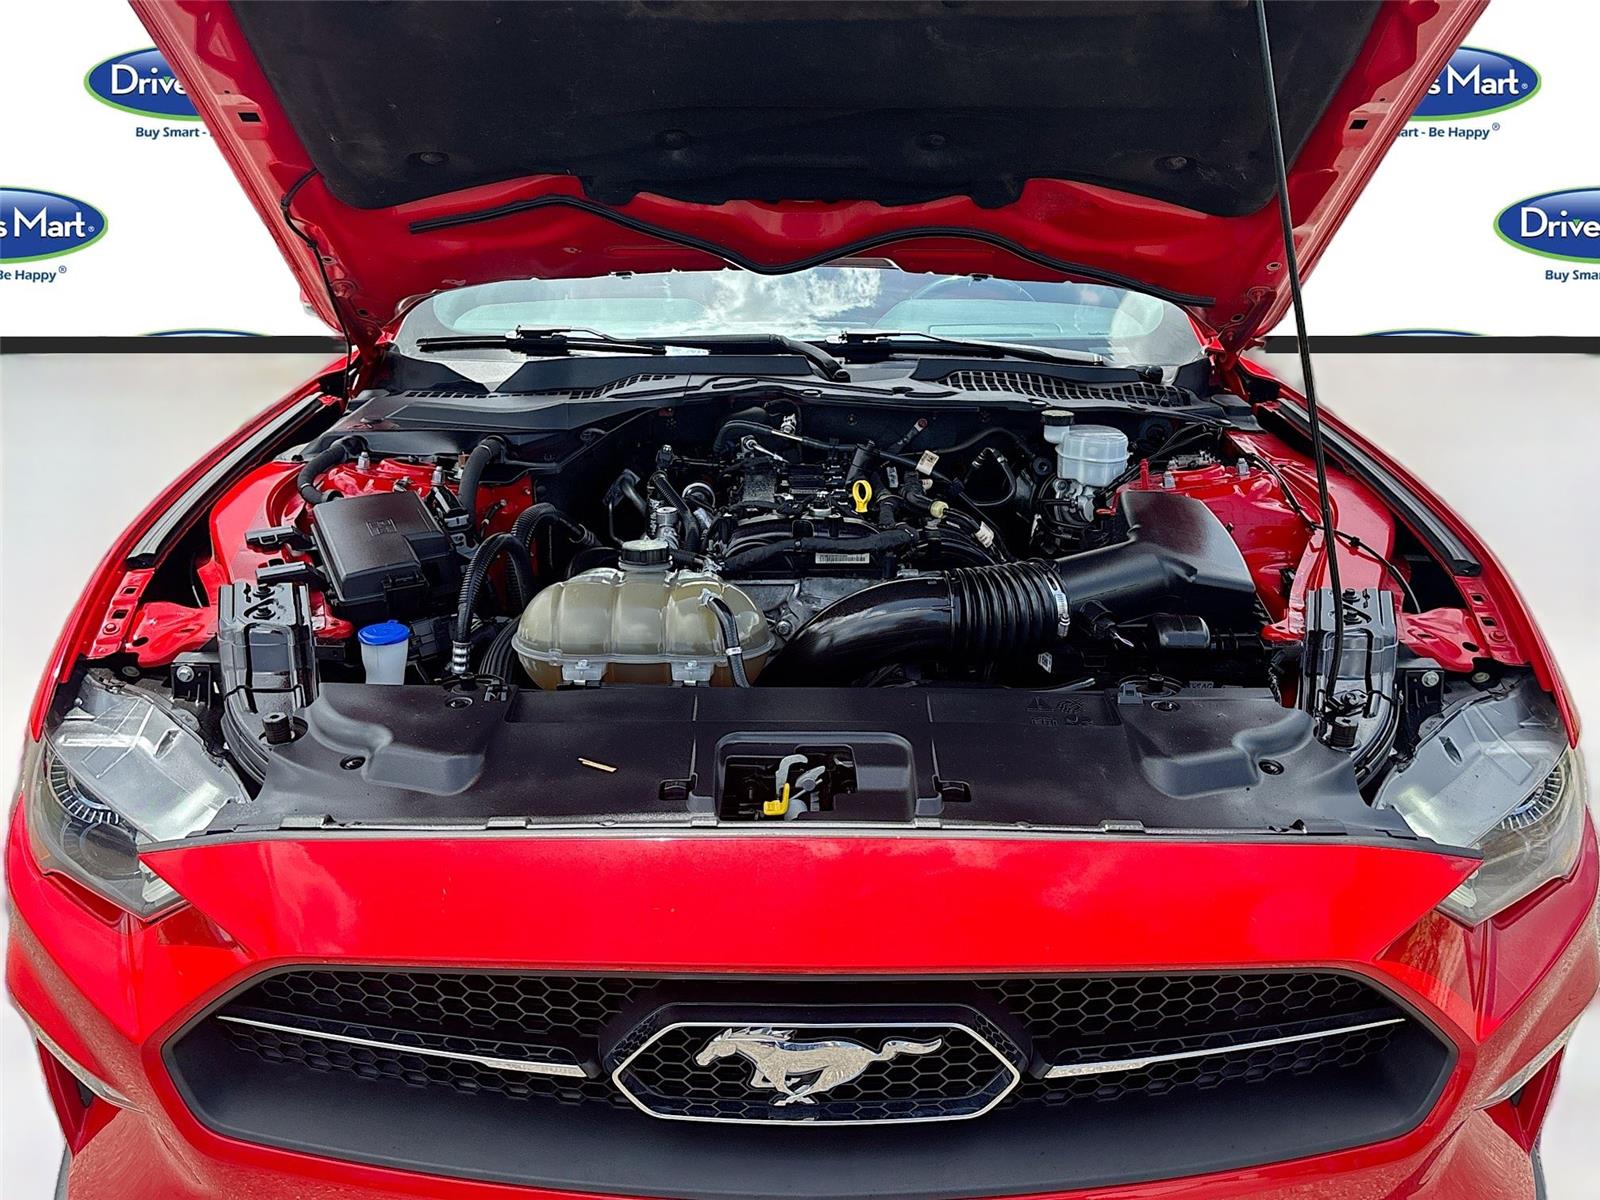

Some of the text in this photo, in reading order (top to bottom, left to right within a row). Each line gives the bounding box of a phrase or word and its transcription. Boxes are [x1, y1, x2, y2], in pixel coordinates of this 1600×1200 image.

[1447, 64, 1519, 95] Mart
[136, 127, 160, 140] Buy
[163, 127, 200, 137] Smart
[1429, 127, 1445, 138] Be
[1448, 127, 1490, 140] Happy
[14, 206, 86, 238] Mart
[1521, 207, 1600, 237] Drive
[15, 270, 57, 283] Happy
[1545, 270, 1570, 283] Buy
